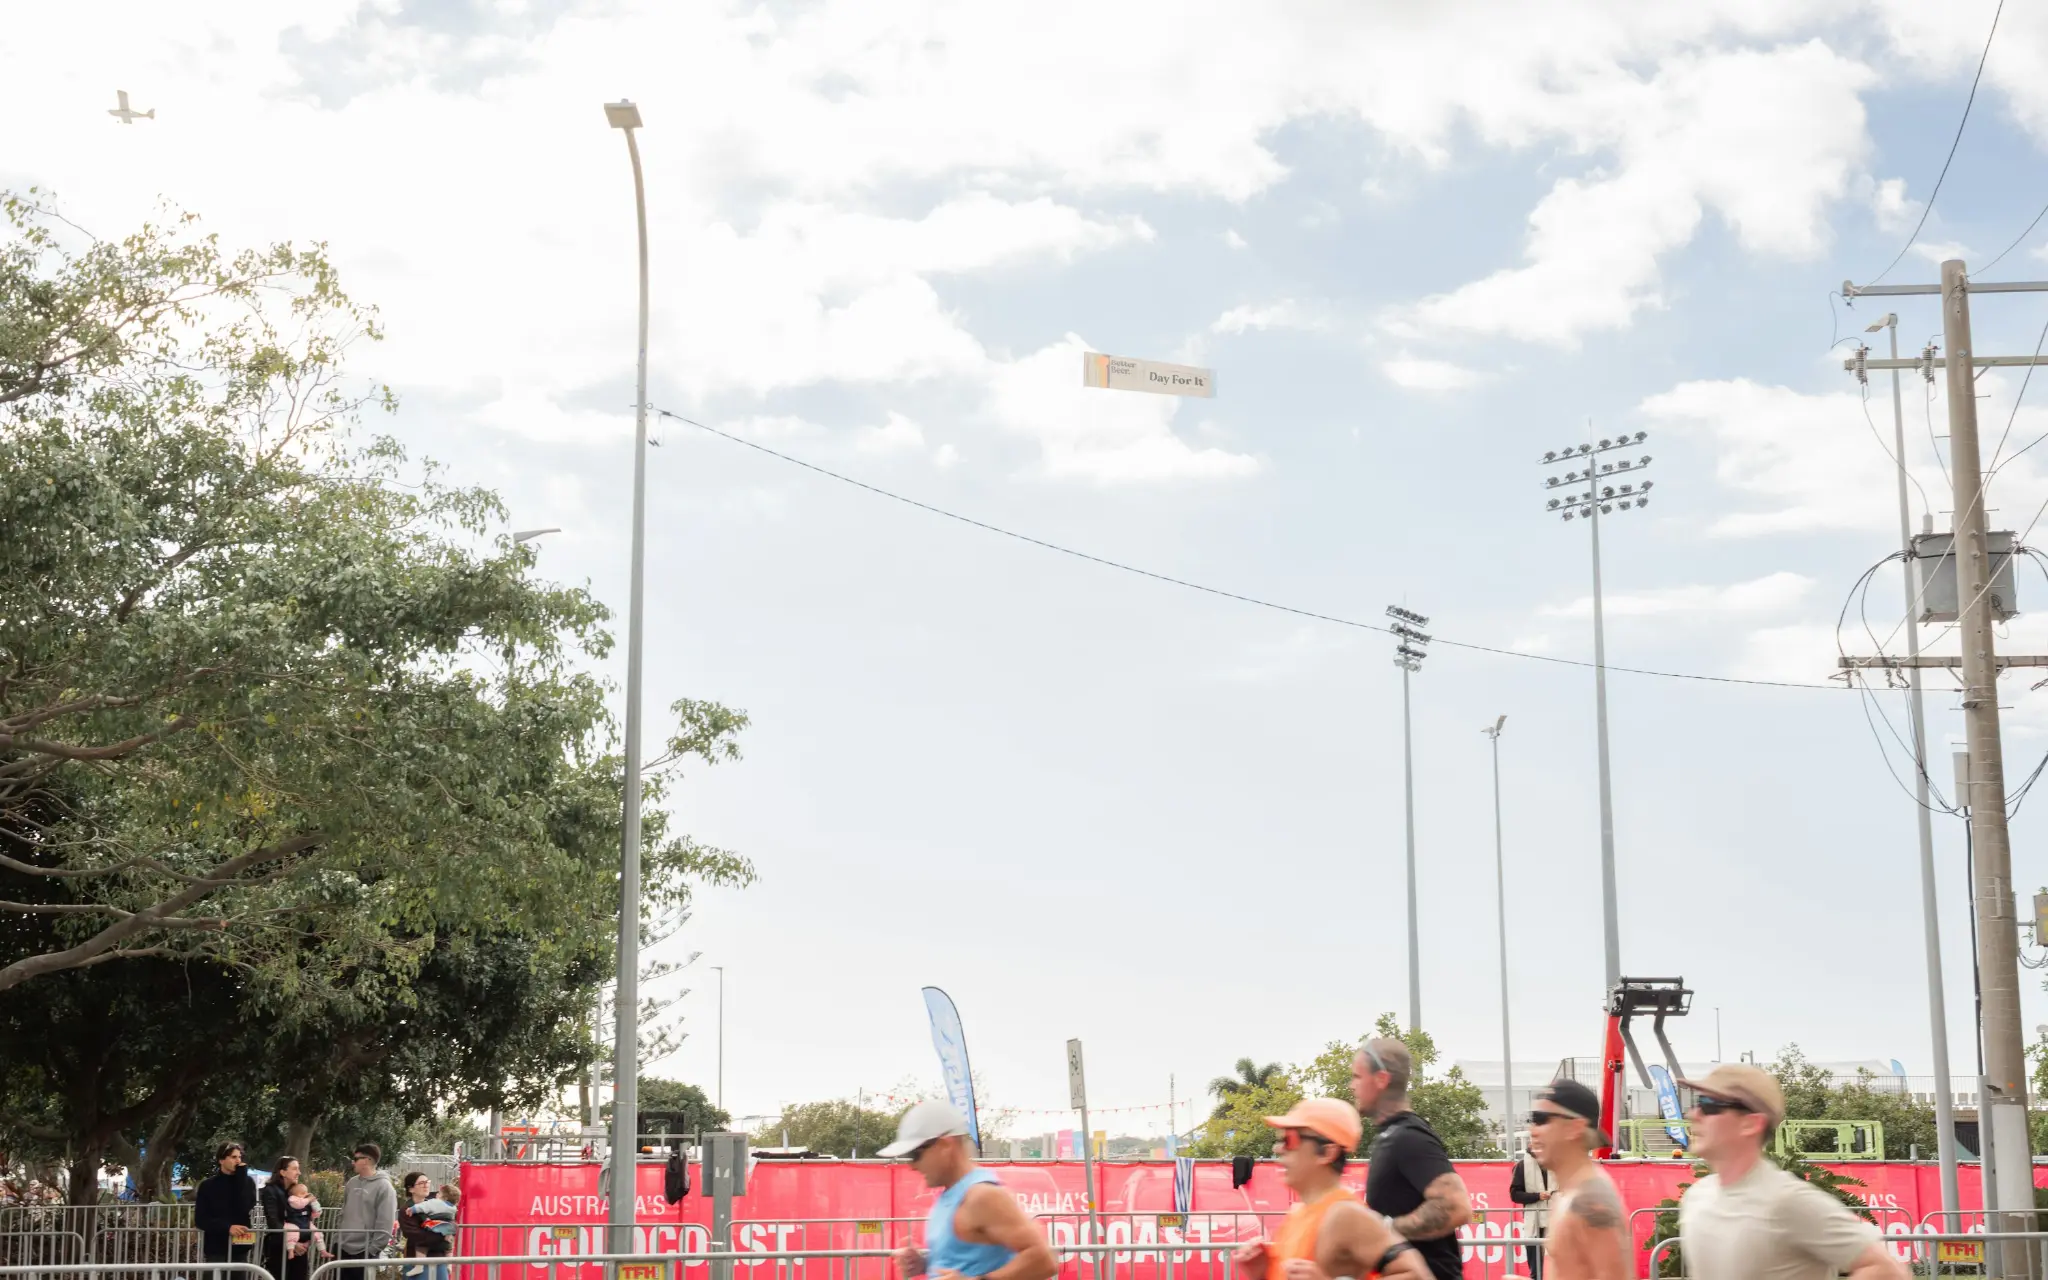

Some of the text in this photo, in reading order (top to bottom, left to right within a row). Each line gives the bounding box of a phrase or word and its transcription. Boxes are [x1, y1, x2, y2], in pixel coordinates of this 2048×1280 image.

[1111, 359, 1136, 369] Better
[1149, 371, 1204, 387] Day For It
[530, 1195, 665, 1216] AUSTRAA'S
[1943, 1242, 1976, 1256] TFH
[622, 1266, 656, 1279] TFH
